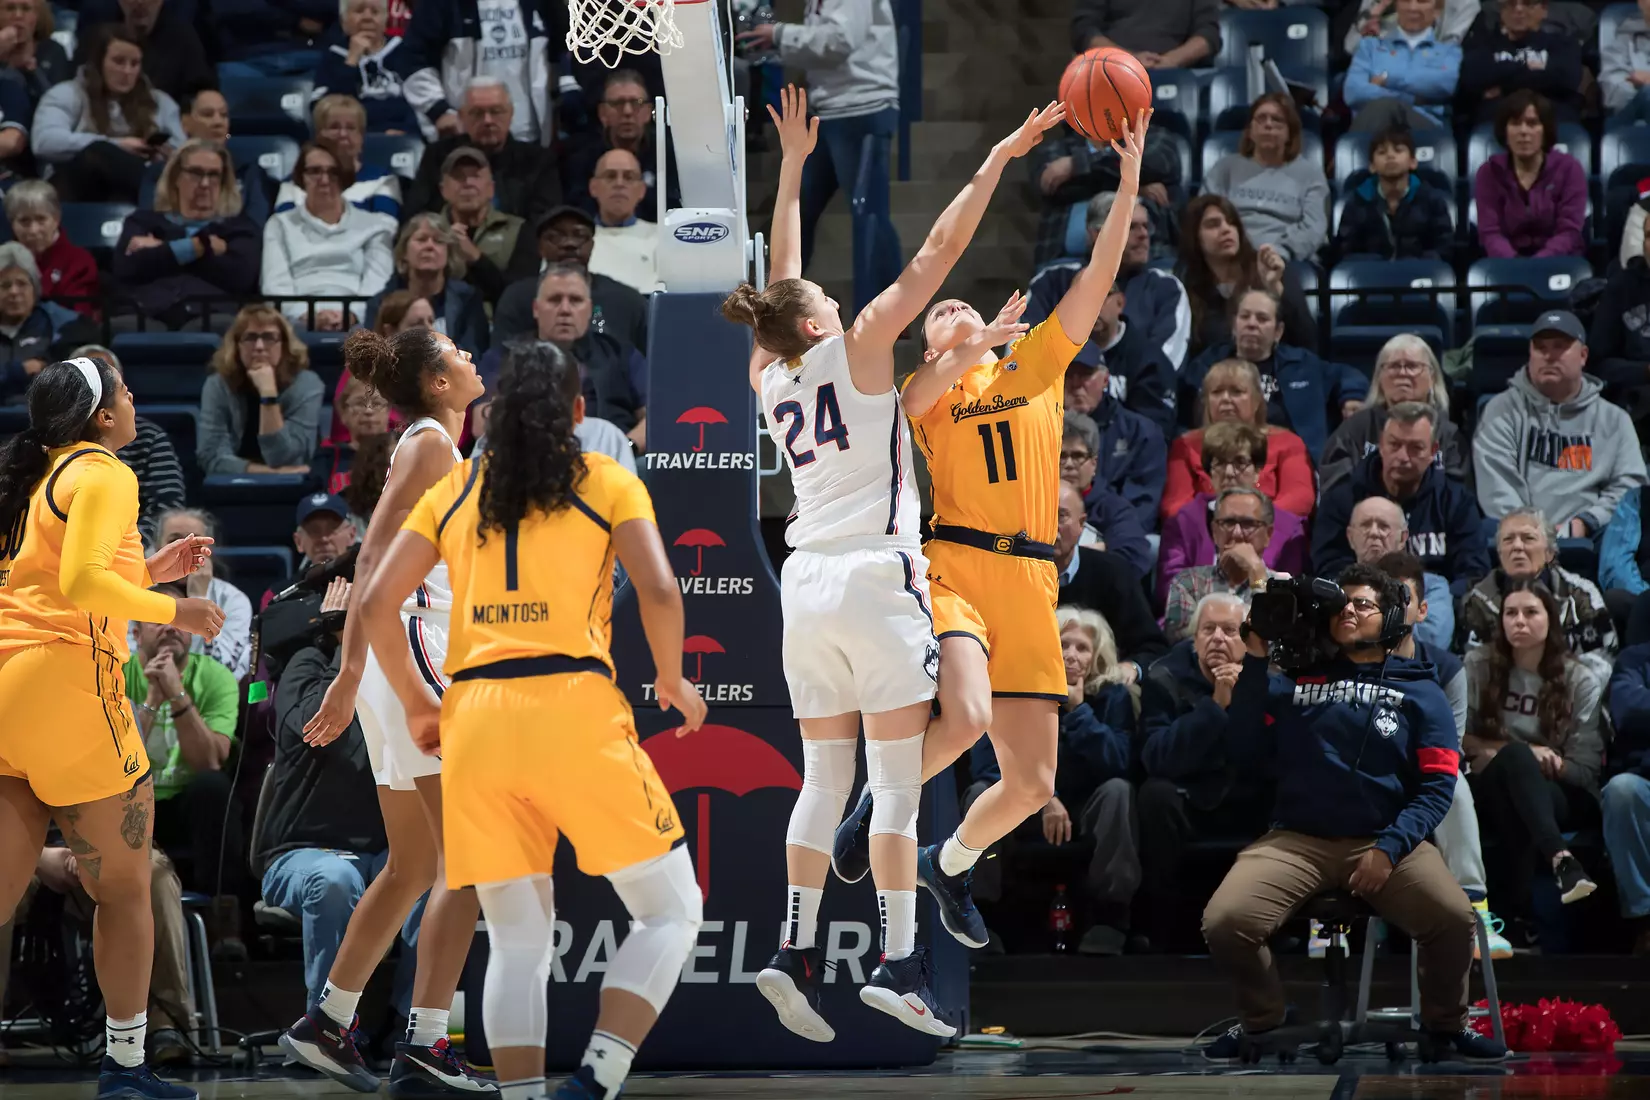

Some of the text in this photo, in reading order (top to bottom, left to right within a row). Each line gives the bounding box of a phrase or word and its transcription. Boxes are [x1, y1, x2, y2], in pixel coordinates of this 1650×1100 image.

[675, 227, 724, 237] SNA
[950, 394, 1029, 424] Golden Bears
[772, 381, 851, 469] 24
[645, 452, 755, 470] TRAVELERS
[977, 420, 1018, 485] 11
[673, 577, 754, 595] VELERS
[472, 602, 549, 624] MCINTOSH
[123, 751, 140, 778] Cal
[655, 807, 675, 836] Cal
